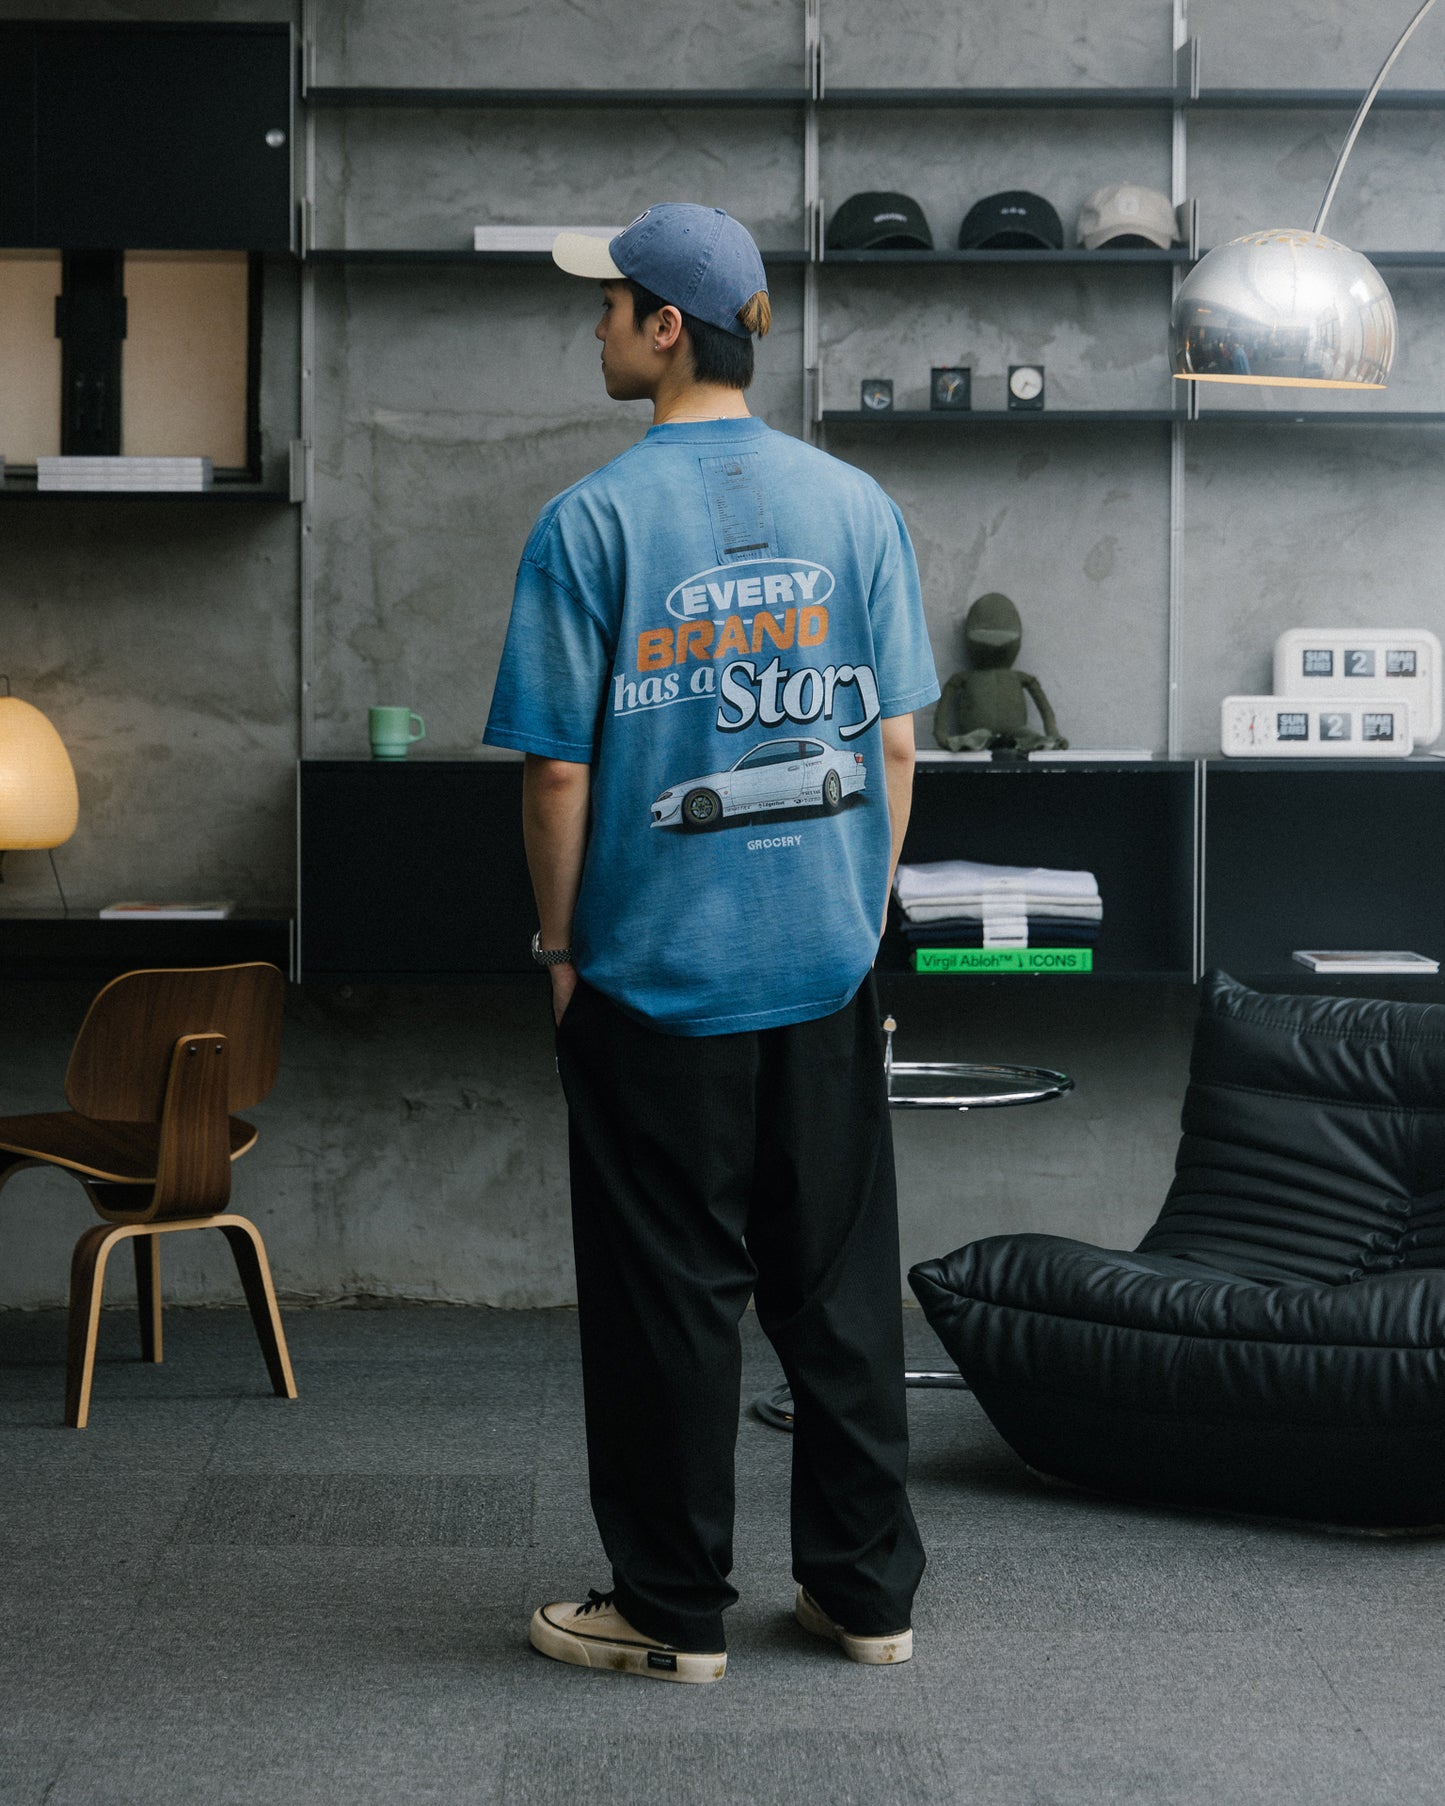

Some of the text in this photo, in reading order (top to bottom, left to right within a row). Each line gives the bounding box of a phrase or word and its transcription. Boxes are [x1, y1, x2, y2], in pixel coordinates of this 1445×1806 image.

[681, 570, 821, 616] EVERY
[636, 605, 829, 673] BRAND
[1351, 651, 1368, 674] 2
[613, 656, 881, 742] has a Story
[1280, 714, 1306, 726] SUN
[1327, 715, 1343, 737] 2
[1365, 715, 1391, 726] MAR
[747, 835, 802, 851] GROCERY
[922, 954, 957, 970] Virgil
[1029, 954, 1077, 967] ICONS
